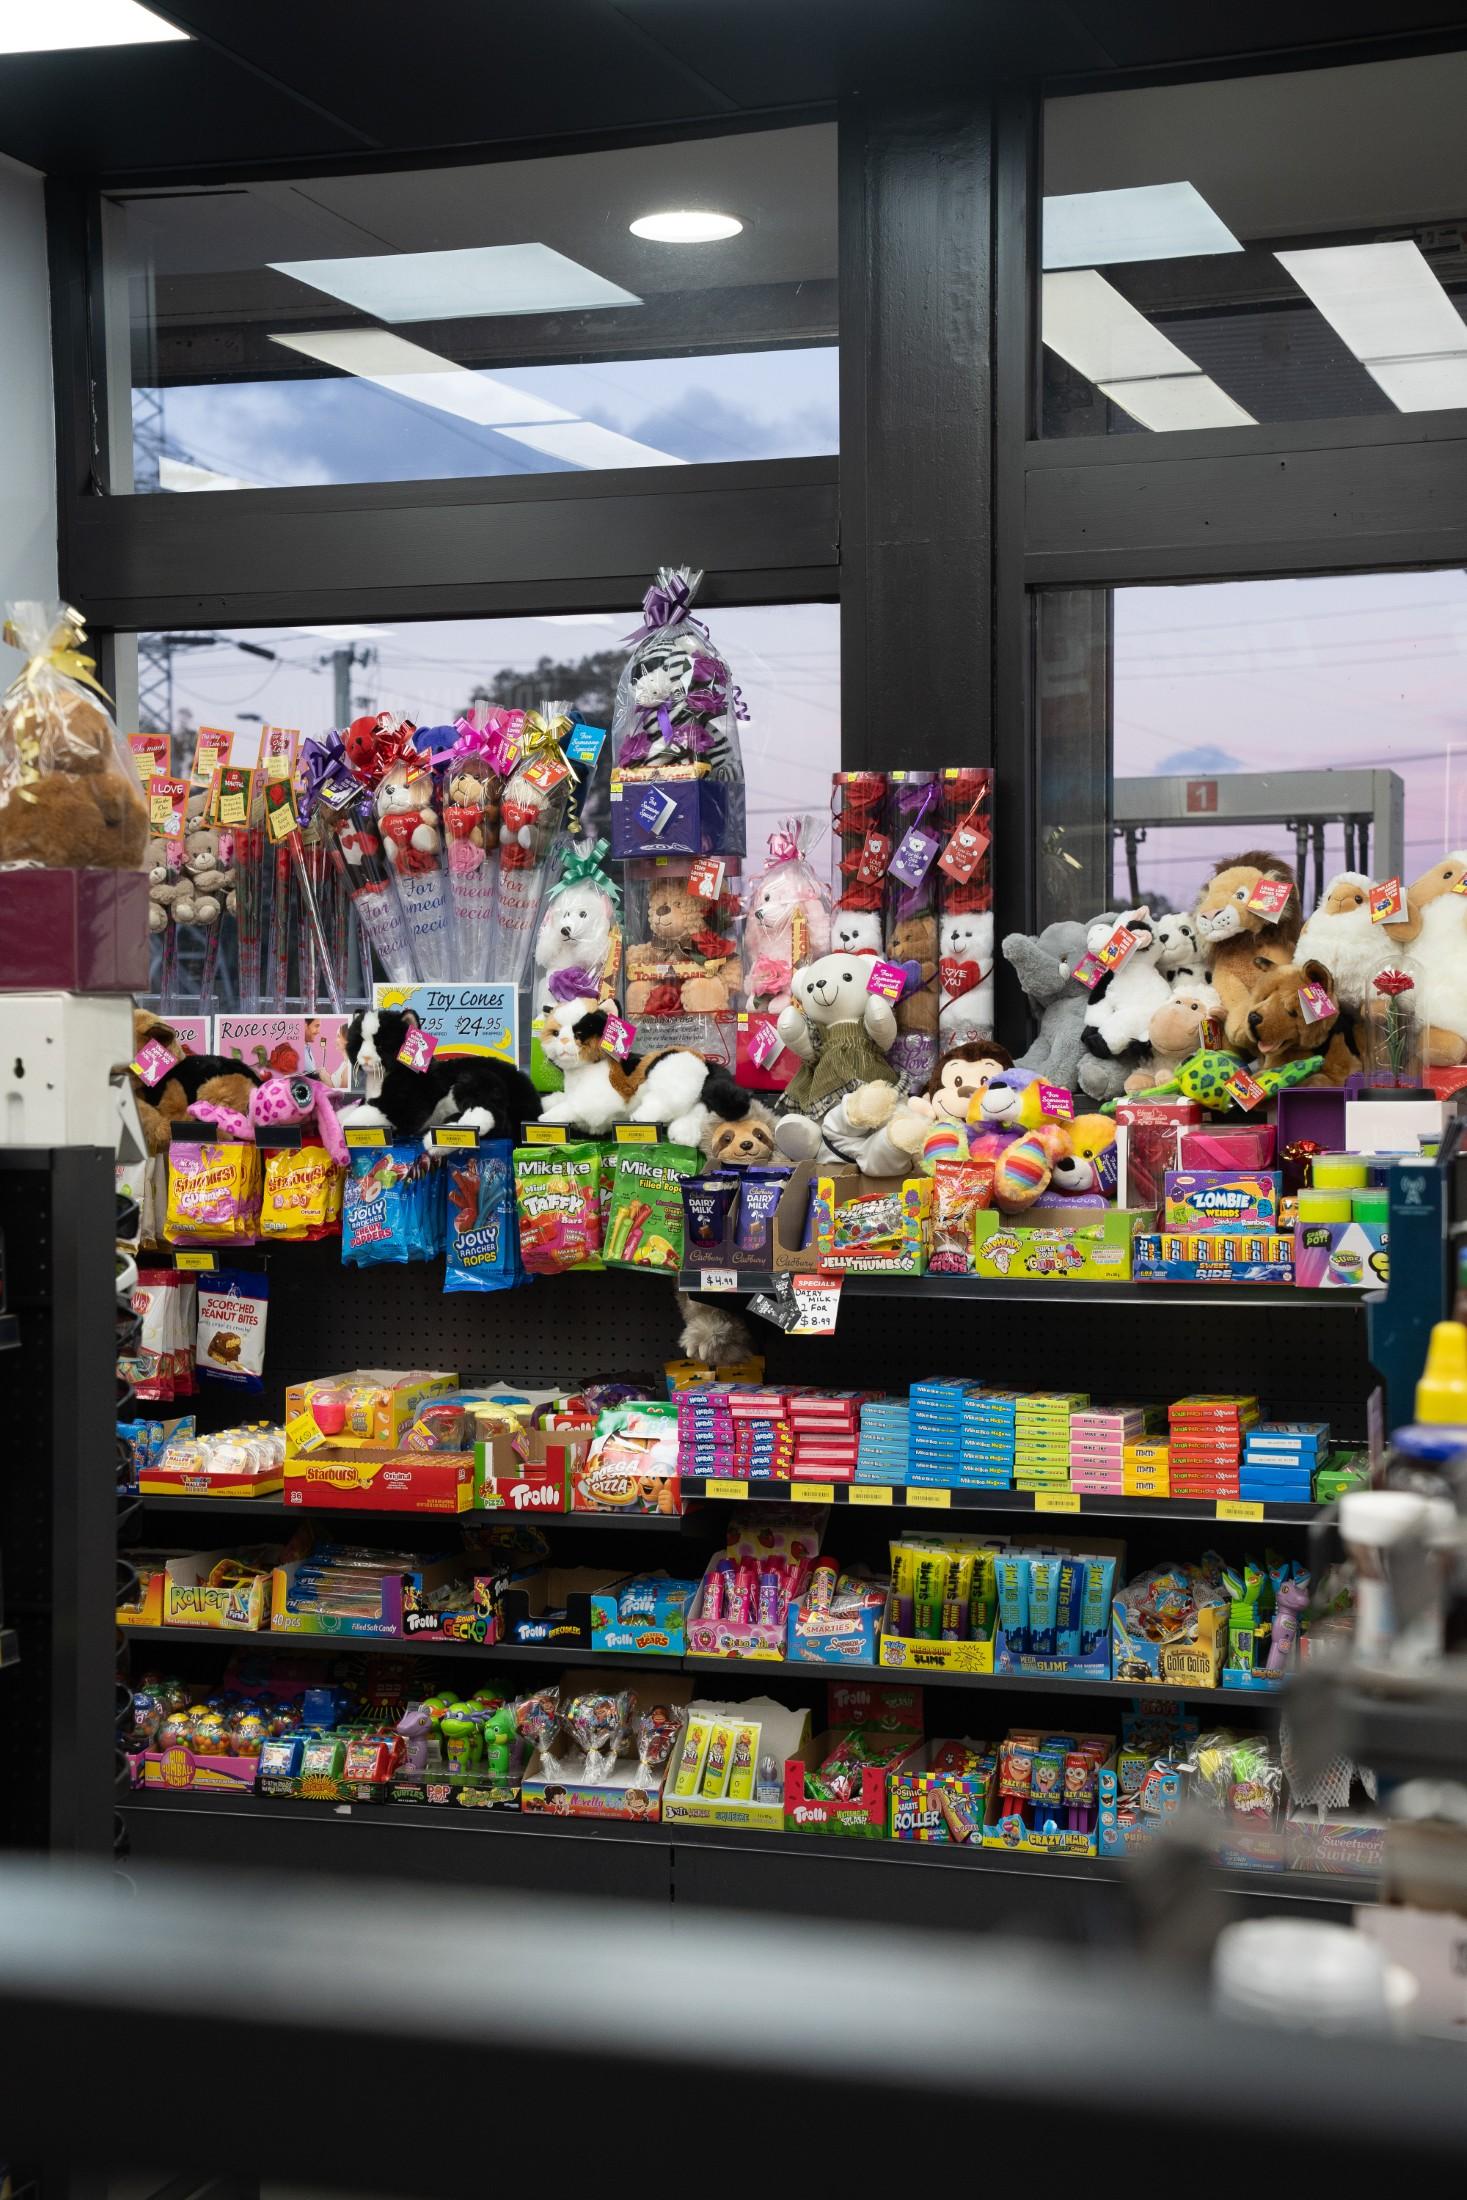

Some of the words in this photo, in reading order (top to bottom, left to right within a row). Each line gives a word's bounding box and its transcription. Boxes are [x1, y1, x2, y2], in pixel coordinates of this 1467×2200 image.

[157, 784, 184, 794] LOVE
[1193, 784, 1209, 810] 1
[402, 878, 435, 897] For
[358, 901, 390, 920] For
[940, 965, 967, 978] LOVE
[943, 977, 962, 988] YOU
[427, 991, 456, 1013] Toy
[460, 990, 505, 1007] Cones
[220, 1021, 269, 1040] Roses
[270, 1020, 301, 1041] $9.95
[455, 1015, 502, 1037] $24.95
[518, 1161, 563, 1176] Mike
[566, 1161, 591, 1175] Ike
[621, 1160, 664, 1178] Mike
[524, 1184, 546, 1194] Mini
[639, 1179, 661, 1190] Filled
[181, 1186, 231, 1207] Gummies
[688, 1199, 716, 1207] DAIRY
[746, 1194, 774, 1203] DAIRY
[1192, 1192, 1250, 1210] ZOMBIE
[348, 1199, 385, 1222] JOLLY
[523, 1194, 584, 1216] TAFFY
[691, 1206, 714, 1215] MILK
[747, 1201, 769, 1210] MILK
[351, 1214, 384, 1229] RANCHER
[561, 1216, 583, 1225] Bars
[1205, 1209, 1240, 1218] WEIRDS
[355, 1223, 382, 1237] CHEWY
[1212, 1218, 1233, 1226] Candy
[1241, 1219, 1271, 1227] Rainbow
[350, 1228, 393, 1248] POPPERS
[455, 1229, 497, 1249] JOLLY
[459, 1244, 496, 1258] RANCHER
[689, 1250, 724, 1264] Cadbury
[731, 1250, 767, 1266] Cadbury
[775, 1254, 815, 1271] Cadbury
[820, 1256, 852, 1269] JELLY
[851, 1257, 900, 1272] THUMBS
[1028, 1255, 1082, 1271] GUMBALLS
[1195, 1269, 1233, 1280] RIDE
[207, 1298, 255, 1315] SCORCHED
[810, 1304, 828, 1312] FOR
[201, 1308, 237, 1322] PEANUT
[237, 1313, 259, 1327] BITES
[306, 1467, 359, 1483] Starburst
[383, 1471, 412, 1481] Original
[599, 1459, 639, 1479] MEGA
[592, 1479, 628, 1493] PIZZA
[290, 1491, 303, 1500] 36
[510, 1482, 561, 1510] Trolli
[918, 1560, 933, 1600] SLIME
[946, 1560, 960, 1599] SLIME
[1060, 1566, 1073, 1607] SLIME
[170, 1586, 230, 1615] Roller
[272, 1613, 286, 1627] 40
[285, 1615, 301, 1630] pcs
[351, 1623, 367, 1633] Filled
[366, 1623, 380, 1633] Soft
[379, 1624, 397, 1634] Candy
[407, 1612, 438, 1631] Trolli
[806, 1623, 850, 1633] SMARTIES
[442, 1618, 488, 1643] GECKO
[517, 1624, 547, 1639] Trolli
[604, 1632, 634, 1648] Trolli
[1036, 1660, 1069, 1672] SLIME
[1166, 1654, 1185, 1672] Gold
[1186, 1655, 1210, 1673] Coins
[833, 1689, 871, 1708] Trolli
[168, 1750, 186, 1763] MINI
[165, 1774, 191, 1788] MACHINE
[390, 1788, 425, 1801] TURTLES
[426, 1784, 451, 1796] POP
[890, 1784, 922, 1800] Cosmic
[569, 1792, 604, 1809] Novelty
[897, 1802, 919, 1812] KARATE
[793, 1806, 828, 1824] Trolli
[894, 1811, 941, 1832] ROLLER
[1028, 1833, 1061, 1847] CRAZY
[1065, 1834, 1089, 1847] HAIR
